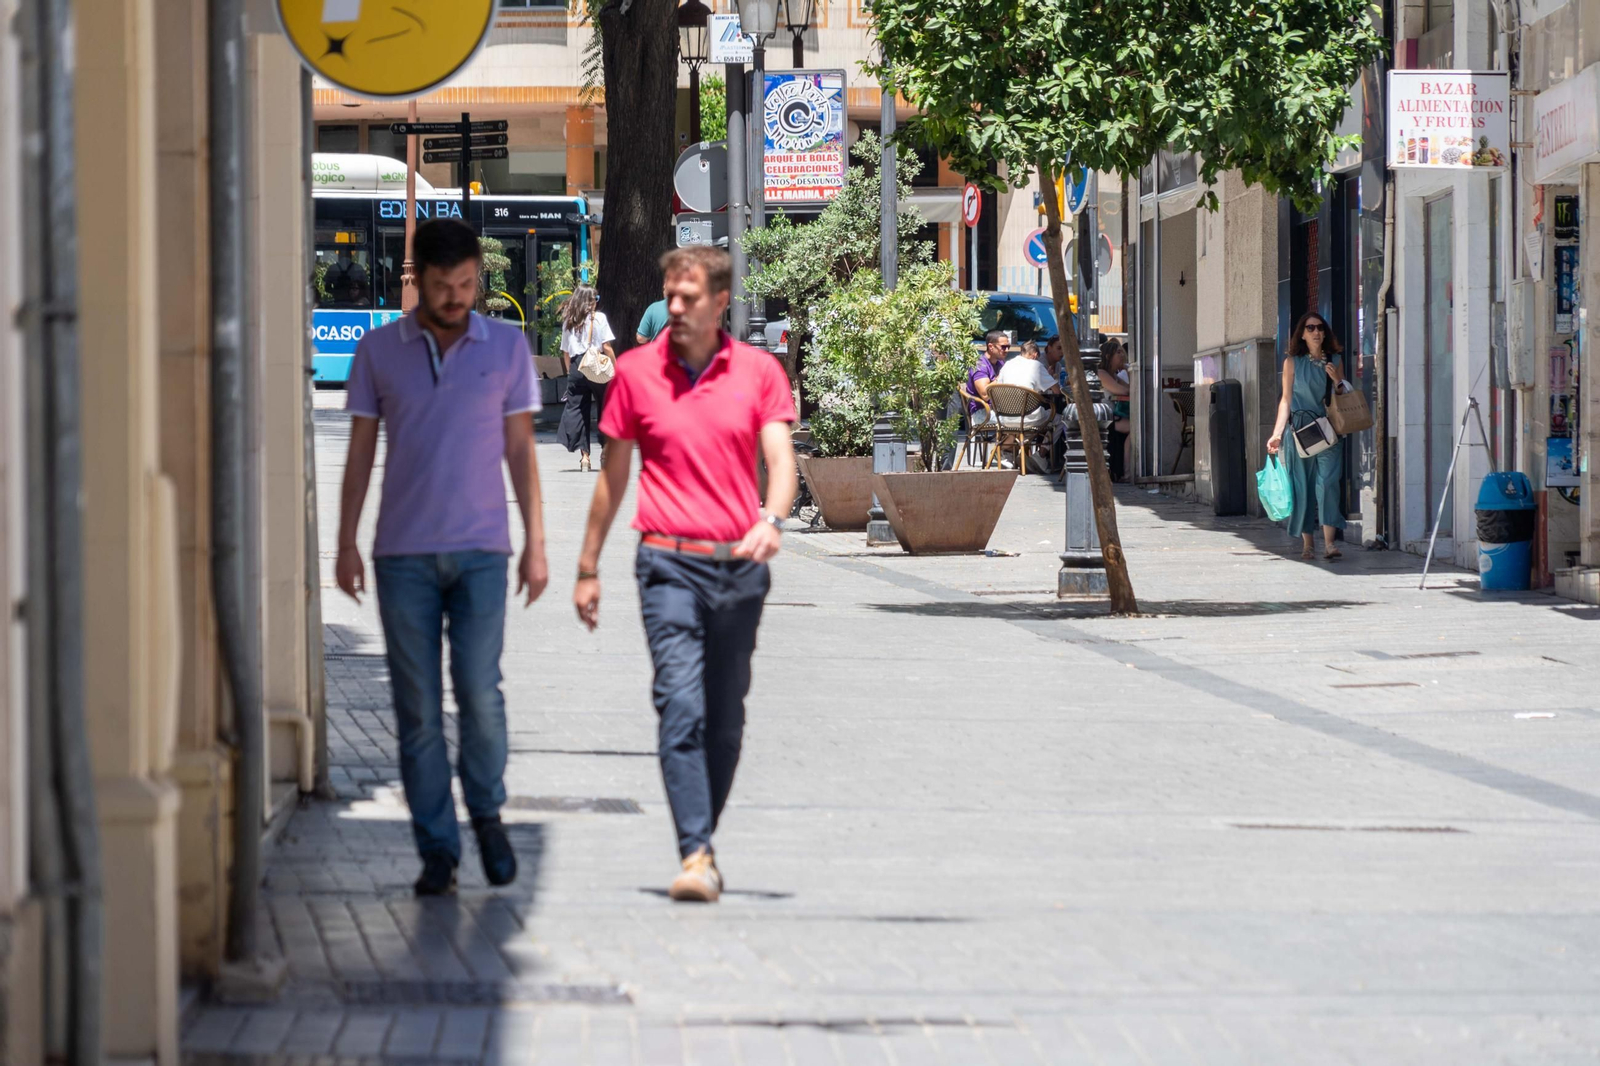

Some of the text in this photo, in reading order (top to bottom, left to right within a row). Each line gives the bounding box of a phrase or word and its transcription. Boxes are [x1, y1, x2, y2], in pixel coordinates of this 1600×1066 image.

[1420, 82, 1478, 96] BAZAR
[764, 81, 828, 111] Coffee Park
[1397, 97, 1504, 114] ALIMENTACIÓN
[1413, 115, 1486, 128] Y FRUTAS
[771, 127, 820, 148] Marina
[764, 153, 839, 163] ARQUE DE BOLAS
[766, 164, 839, 174] CELEBRACIONES
[765, 177, 841, 186] ENTOS DESAYUNOS
[436, 201, 463, 218] BA
[494, 207, 509, 217] 316
